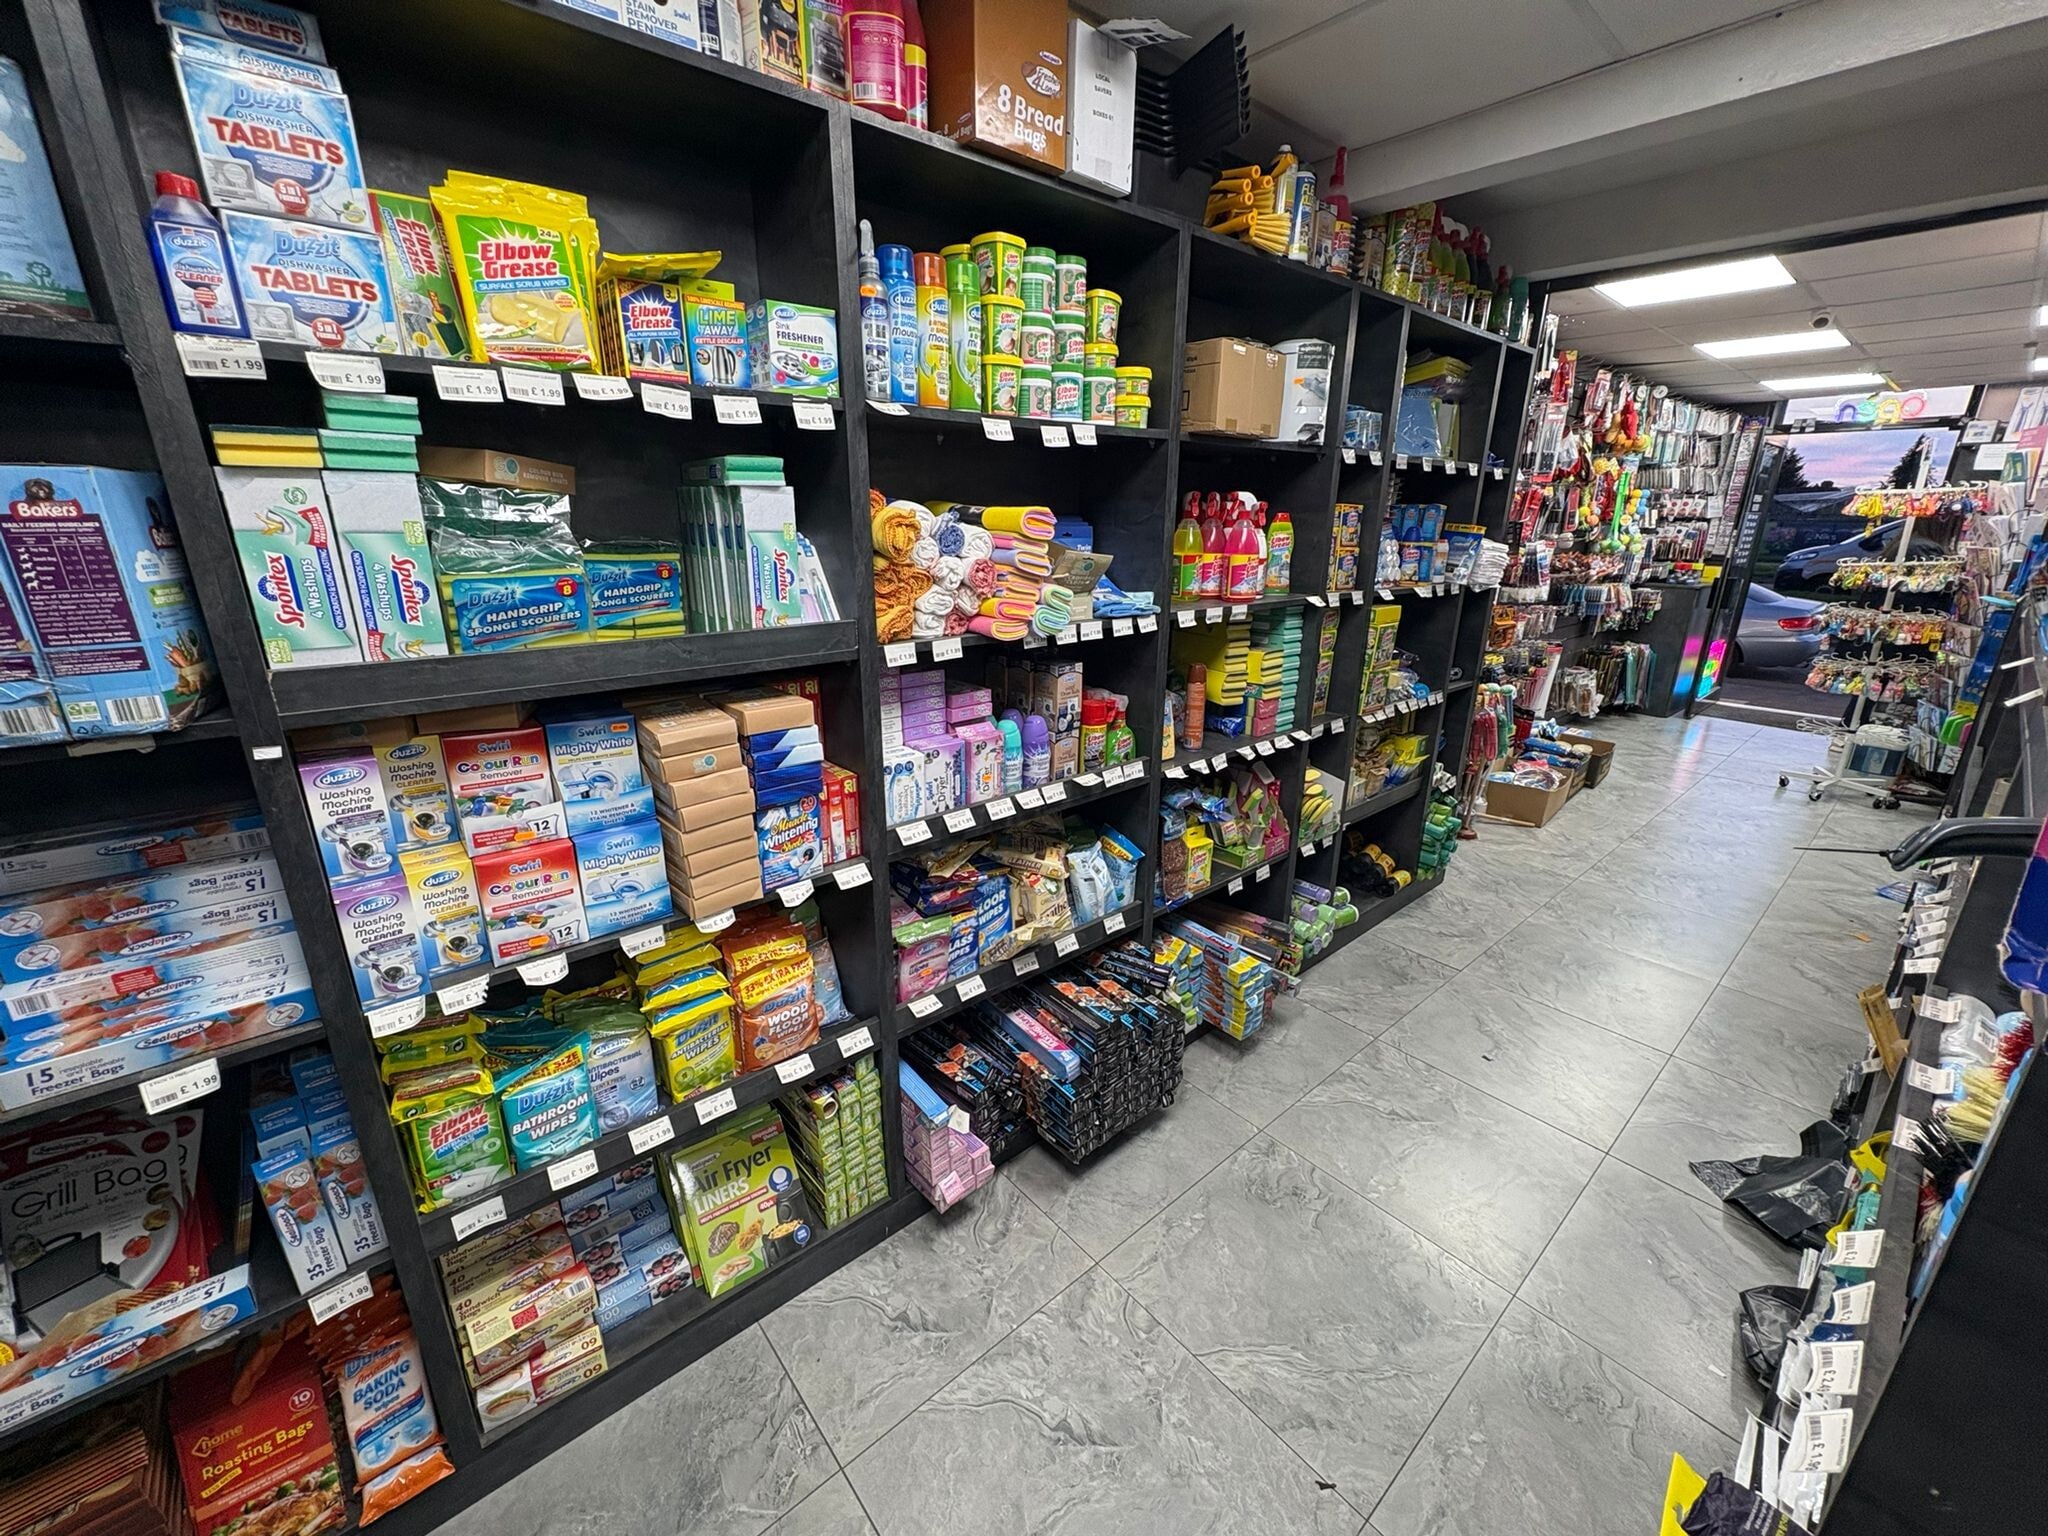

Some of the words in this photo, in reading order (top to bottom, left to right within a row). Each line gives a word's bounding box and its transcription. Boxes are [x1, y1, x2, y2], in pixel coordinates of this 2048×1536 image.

[626, 0, 656, 14] STAIN
[220, 10, 303, 44] TABLETS
[627, 8, 678, 31] REMOVER
[628, 18, 653, 34] PEN
[243, 55, 320, 82] DISHWASHER
[1096, 73, 1111, 83] LOCAL
[1095, 86, 1112, 96] SAVERS
[999, 85, 1011, 113] 8
[1015, 96, 1063, 136] Bread
[236, 110, 313, 134] DISHWASHER
[208, 117, 344, 165] TABLETS
[1015, 123, 1047, 153] Bags
[276, 232, 340, 258] Duzzit
[396, 218, 425, 275] Grease
[411, 220, 440, 276] Elbow
[480, 243, 552, 261] Elbow
[175, 271, 224, 284] CLEANER
[484, 261, 557, 279] Grease
[251, 266, 378, 302] TABLETS
[478, 282, 514, 290] SURFACE
[516, 281, 541, 289] SCRUB
[542, 279, 567, 287] WIPES
[630, 305, 670, 318] Elbow
[700, 310, 736, 325] LIME
[632, 318, 672, 329] Grease
[776, 321, 790, 330] Sink
[777, 331, 823, 345] FRESHENER
[221, 359, 230, 368] £
[234, 360, 262, 370] 1.99
[346, 374, 353, 383] £
[357, 375, 382, 384] 1.99
[532, 387, 538, 396] £
[540, 388, 561, 398] 1.99
[18, 501, 78, 518] Bakers
[301, 559, 322, 608] Washups
[591, 568, 628, 584] Duzzit
[773, 549, 789, 603] Spontex
[268, 554, 305, 628] Spontex
[375, 573, 392, 620] Washups
[391, 554, 421, 624] Spontex
[468, 587, 520, 608] Duzzit
[629, 590, 674, 603] SCOURERS
[486, 602, 563, 622] HANDGRIP
[467, 620, 520, 638] SPONGE
[523, 610, 581, 631] SCOURERS
[577, 726, 606, 737] Swirl
[391, 745, 426, 759] duzzit
[478, 740, 511, 753] Swirl
[555, 741, 597, 756] Mighty
[599, 736, 633, 749] White
[389, 761, 434, 773] Washing
[457, 758, 508, 773] Colour
[512, 753, 540, 767] Run
[322, 768, 359, 784] duzzit
[396, 778, 434, 788] CLEANER
[481, 769, 523, 780] Remover
[319, 787, 371, 801] Washing
[322, 795, 374, 810] Machine
[328, 804, 371, 817] CLEANER
[599, 804, 629, 814] WHITENER
[534, 820, 550, 832] 12
[764, 818, 818, 850] Whitening
[510, 861, 542, 874] Swirl
[584, 854, 626, 870] Mighty
[628, 846, 660, 859] White
[187, 877, 217, 889] Bags
[223, 869, 263, 882] Freezer
[246, 876, 266, 892] 15
[424, 871, 458, 886] duzzit
[488, 876, 539, 895] Colour
[543, 870, 570, 886] Run
[511, 886, 554, 902] Remover
[978, 889, 1006, 914] LOOR
[111, 900, 173, 921] Sealapack
[557, 926, 572, 939] 12
[641, 939, 646, 948] £
[648, 936, 663, 946] 1.49
[950, 934, 974, 951] LASS
[763, 986, 806, 1012] Duzzit
[768, 1002, 808, 1026] WOOD
[676, 1013, 720, 1046] Duzzit
[769, 1012, 808, 1036] FLOOR
[671, 1023, 729, 1060] ANTIBACTERIAL
[686, 1037, 721, 1061] WIPES
[27, 1068, 54, 1087] 15
[31, 1075, 85, 1096] Freezer
[91, 1063, 125, 1081] Bags
[180, 1084, 188, 1094] £
[192, 1074, 218, 1091] 1.99
[518, 1080, 575, 1115] Duzzit
[431, 1103, 483, 1139] Elbow
[512, 1094, 588, 1135] BATHROOM
[433, 1114, 488, 1149] Grease
[531, 1114, 577, 1140] WIPES
[650, 1133, 655, 1141] £
[656, 1128, 671, 1140] 1.99
[571, 1169, 577, 1177] £
[578, 1162, 595, 1174] 1.99
[694, 1169, 718, 1193] Air
[722, 1146, 771, 1180] Fryer
[11, 1179, 77, 1218] Grill
[95, 1159, 168, 1196] Bag
[693, 1178, 749, 1216] LINERS
[361, 1201, 372, 1219] Bags
[313, 1227, 325, 1245] Bags
[367, 1221, 379, 1246] Freezer
[321, 1246, 335, 1273] Freezer
[307, 1264, 325, 1280] 35
[339, 1296, 346, 1304] £
[349, 1285, 369, 1299] 1.99
[459, 1293, 500, 1315] Sandwich
[456, 1299, 472, 1311] 40
[460, 1310, 481, 1321] Bags
[77, 1339, 139, 1374] Sealapack
[353, 1360, 410, 1404] BAKING
[292, 1391, 311, 1404] 10
[363, 1378, 406, 1411] SODA
[202, 1439, 273, 1480] Roasting
[275, 1420, 314, 1443] Bags
